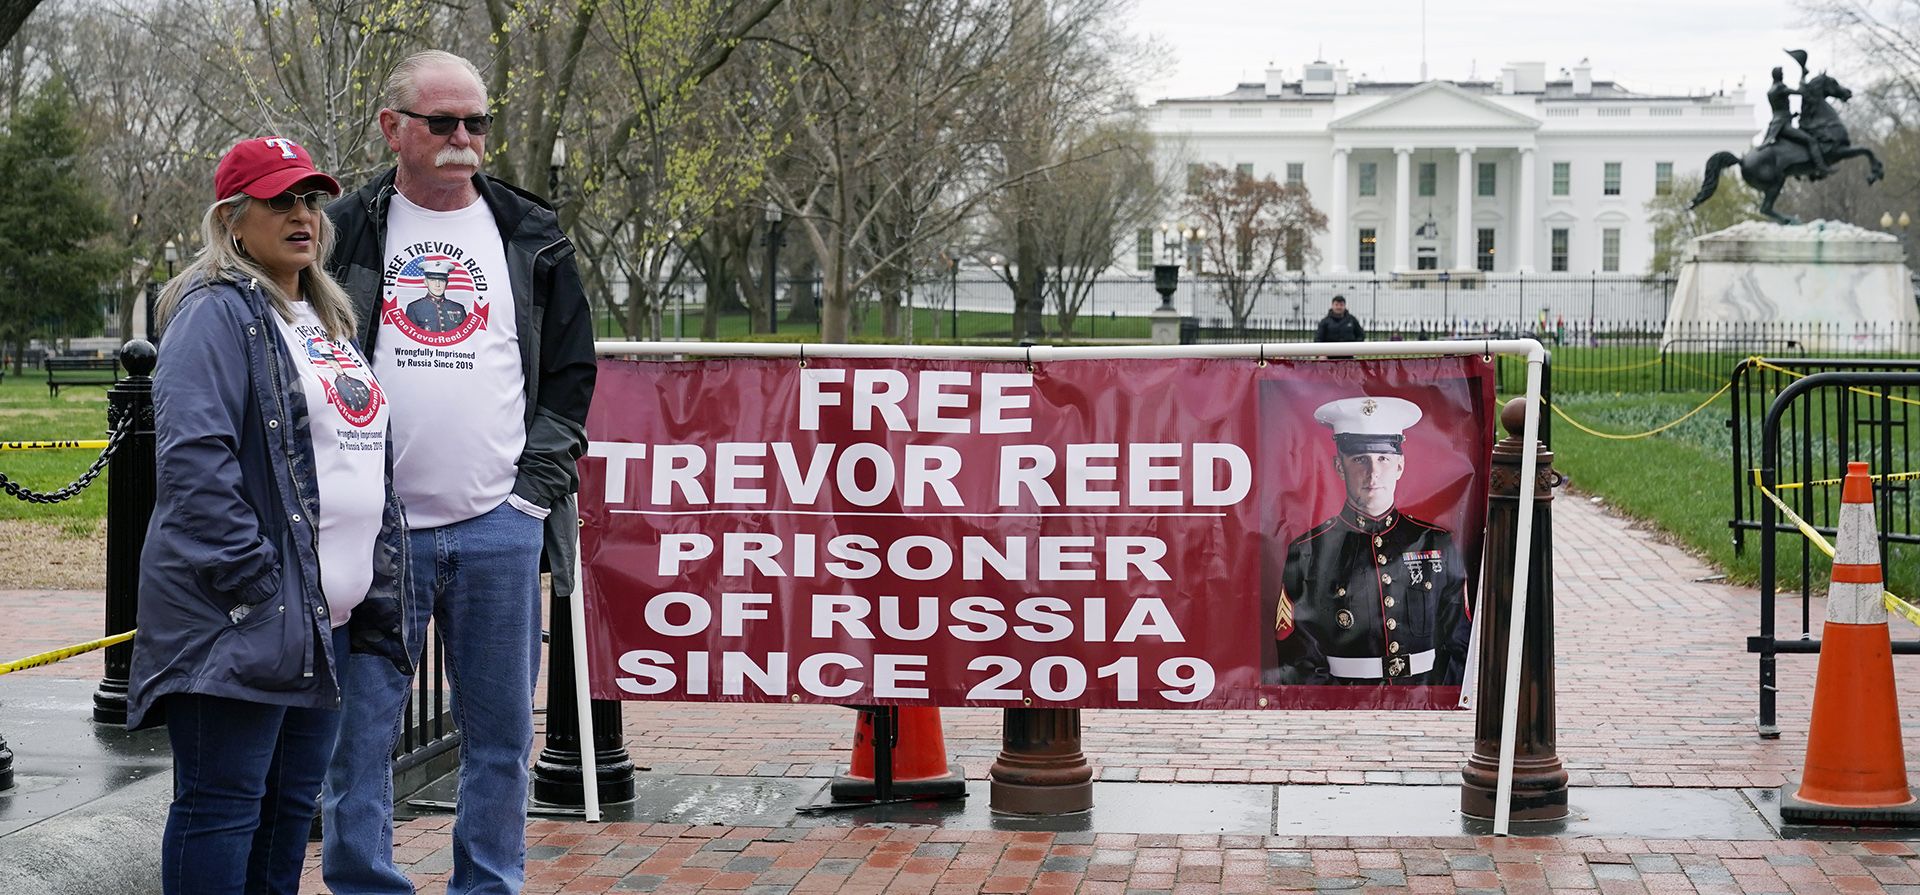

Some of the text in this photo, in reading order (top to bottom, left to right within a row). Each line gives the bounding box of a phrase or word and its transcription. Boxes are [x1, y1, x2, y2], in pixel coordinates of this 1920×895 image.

[264, 138, 297, 159] T
[383, 241, 488, 292] FREE TREVOR REED
[392, 311, 478, 344] FreeTrevorReed.com
[394, 347, 476, 360] Wrongfully Imprisoned
[397, 358, 474, 370] by Russia Since 2019
[800, 366, 1034, 435] FREE
[587, 441, 1252, 507] TREVOR REED
[658, 533, 1171, 581] PRISONER
[645, 592, 1186, 642] OF RUSSIA
[616, 650, 1216, 702] SINCE 2019
